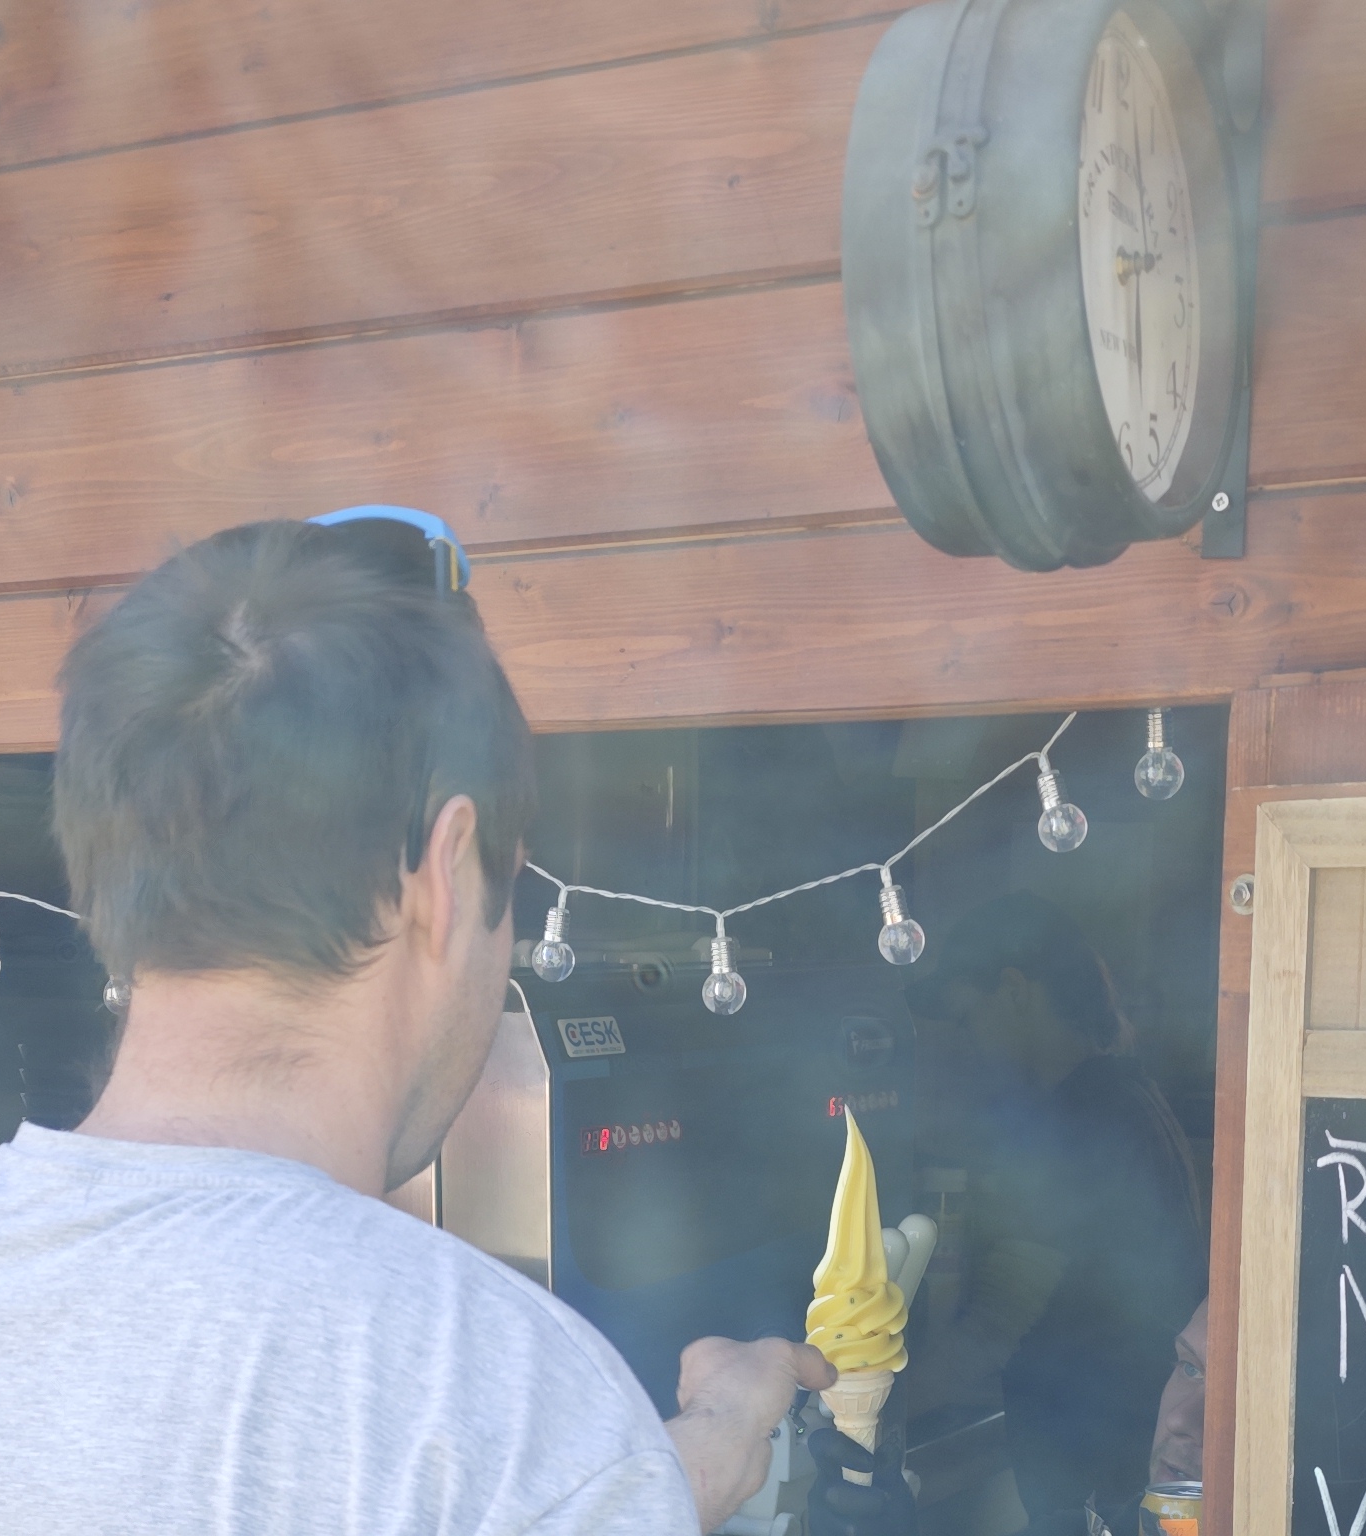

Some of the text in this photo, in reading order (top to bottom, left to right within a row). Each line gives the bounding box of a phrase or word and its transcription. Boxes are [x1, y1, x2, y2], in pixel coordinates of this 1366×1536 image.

[1165, 361, 1182, 410] 4
[1147, 412, 1161, 468] 5
[564, 1021, 621, 1047] CESK
